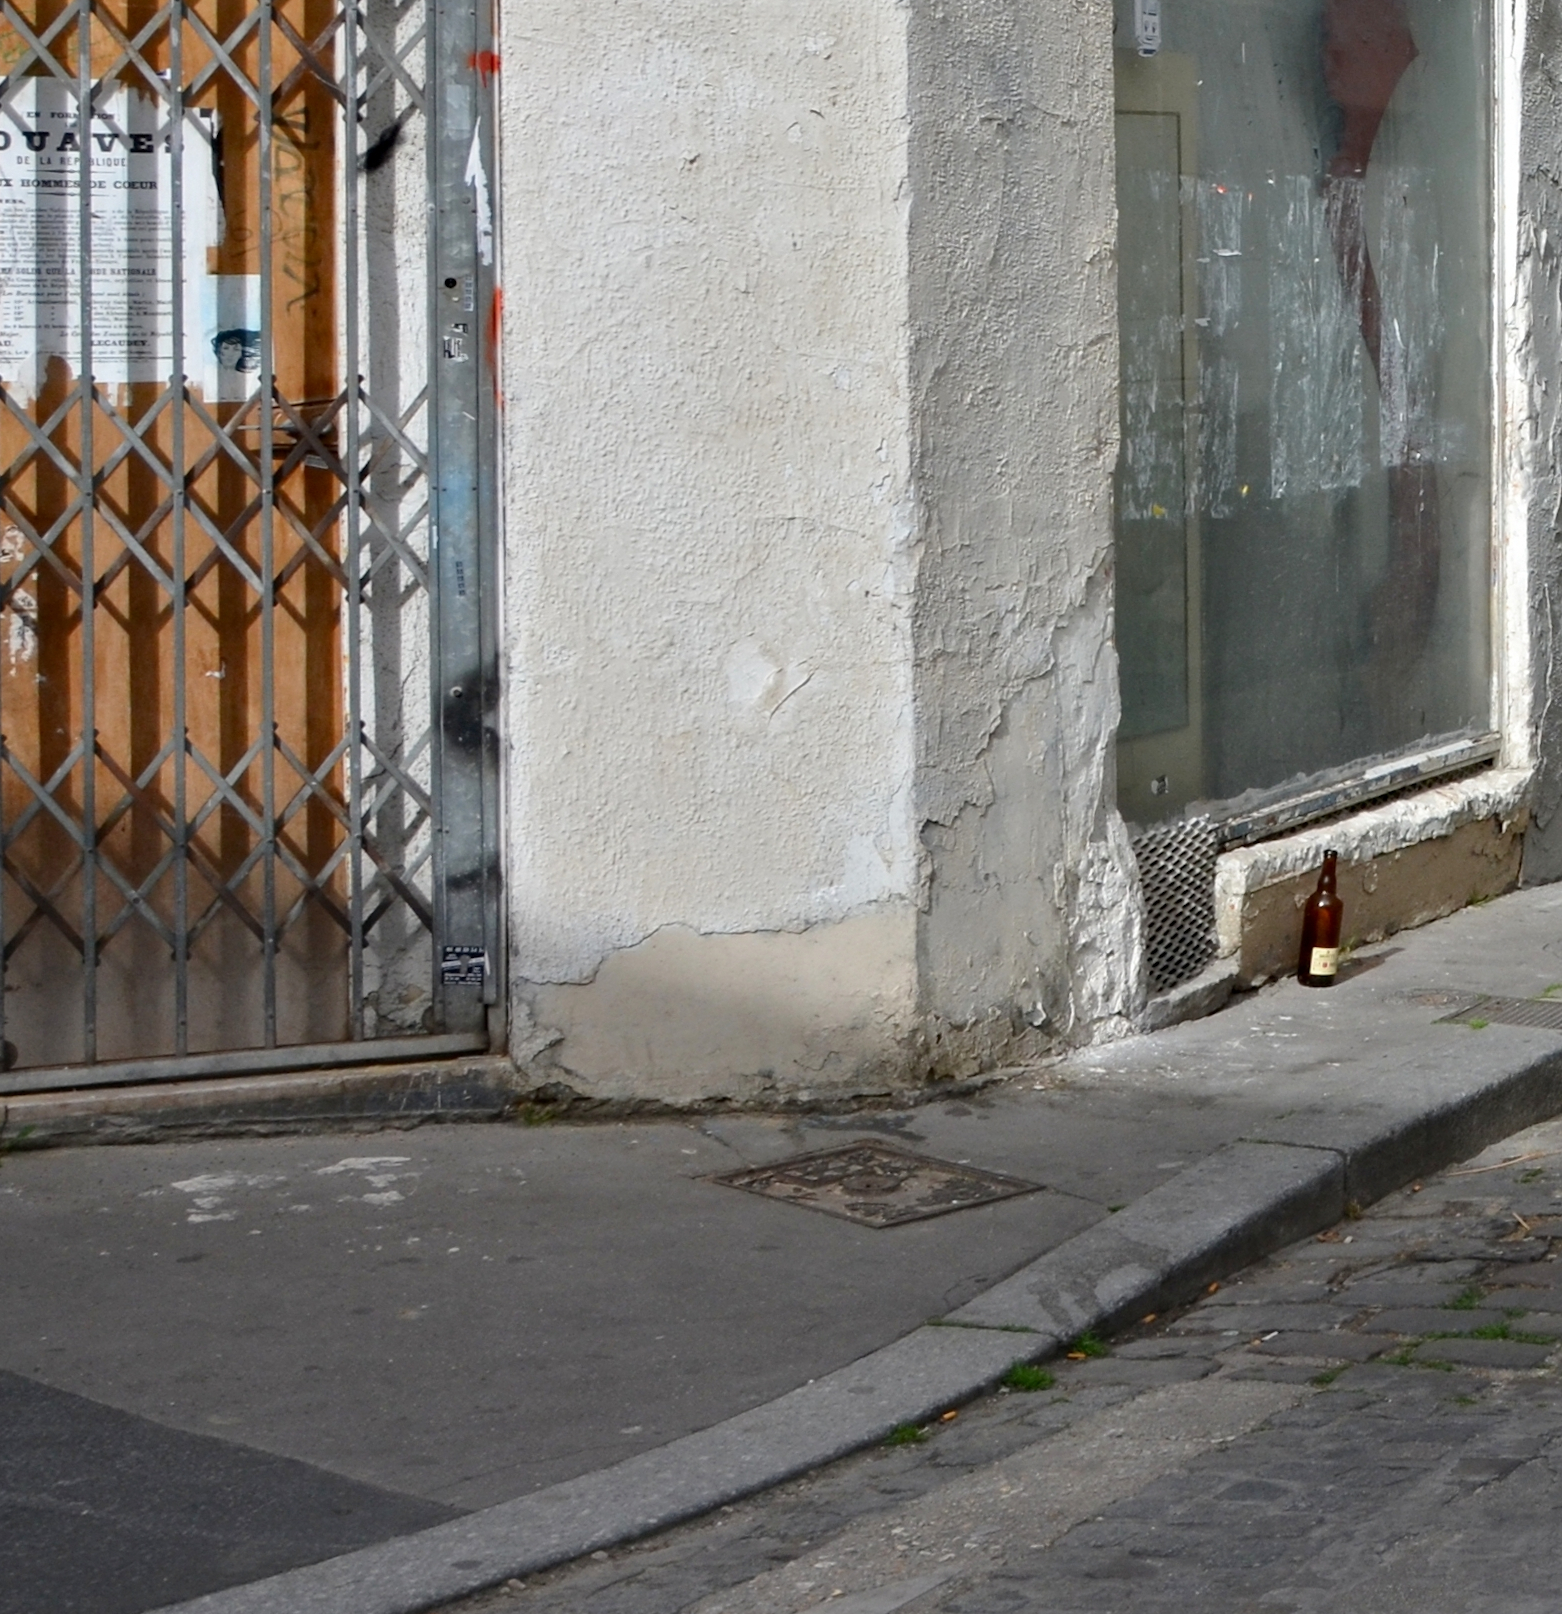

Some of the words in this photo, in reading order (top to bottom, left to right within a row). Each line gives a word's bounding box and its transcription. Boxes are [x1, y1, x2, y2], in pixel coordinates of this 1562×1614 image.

[17, 156, 31, 165] DE
[40, 157, 52, 166] LA
[21, 178, 80, 188] HOMMES
[90, 180, 107, 190] DE
